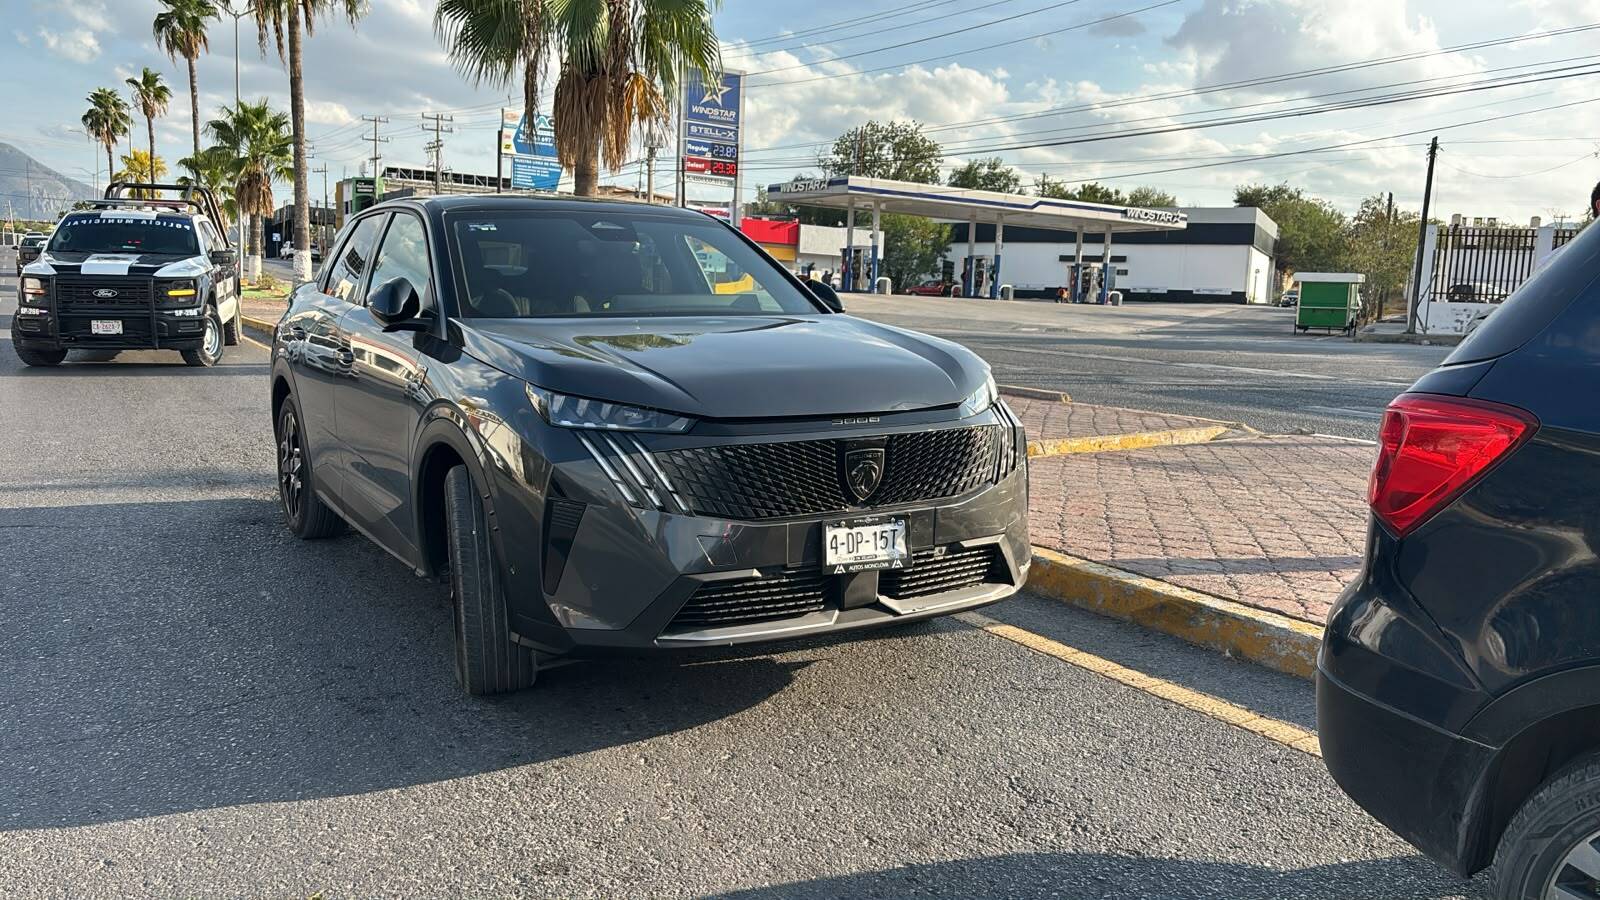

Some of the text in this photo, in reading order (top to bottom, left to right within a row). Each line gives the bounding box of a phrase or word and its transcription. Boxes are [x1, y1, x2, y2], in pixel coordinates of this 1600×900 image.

[691, 104, 737, 119] WINDSTAR
[690, 125, 736, 138] STELL-X
[687, 143, 709, 152] Regular
[713, 144, 737, 158] 23.89
[712, 162, 736, 175] 29.30
[780, 179, 821, 193] WINDSTAR
[1127, 208, 1173, 222] WINDSTAR
[830, 529, 898, 555] 4-DP-15T
